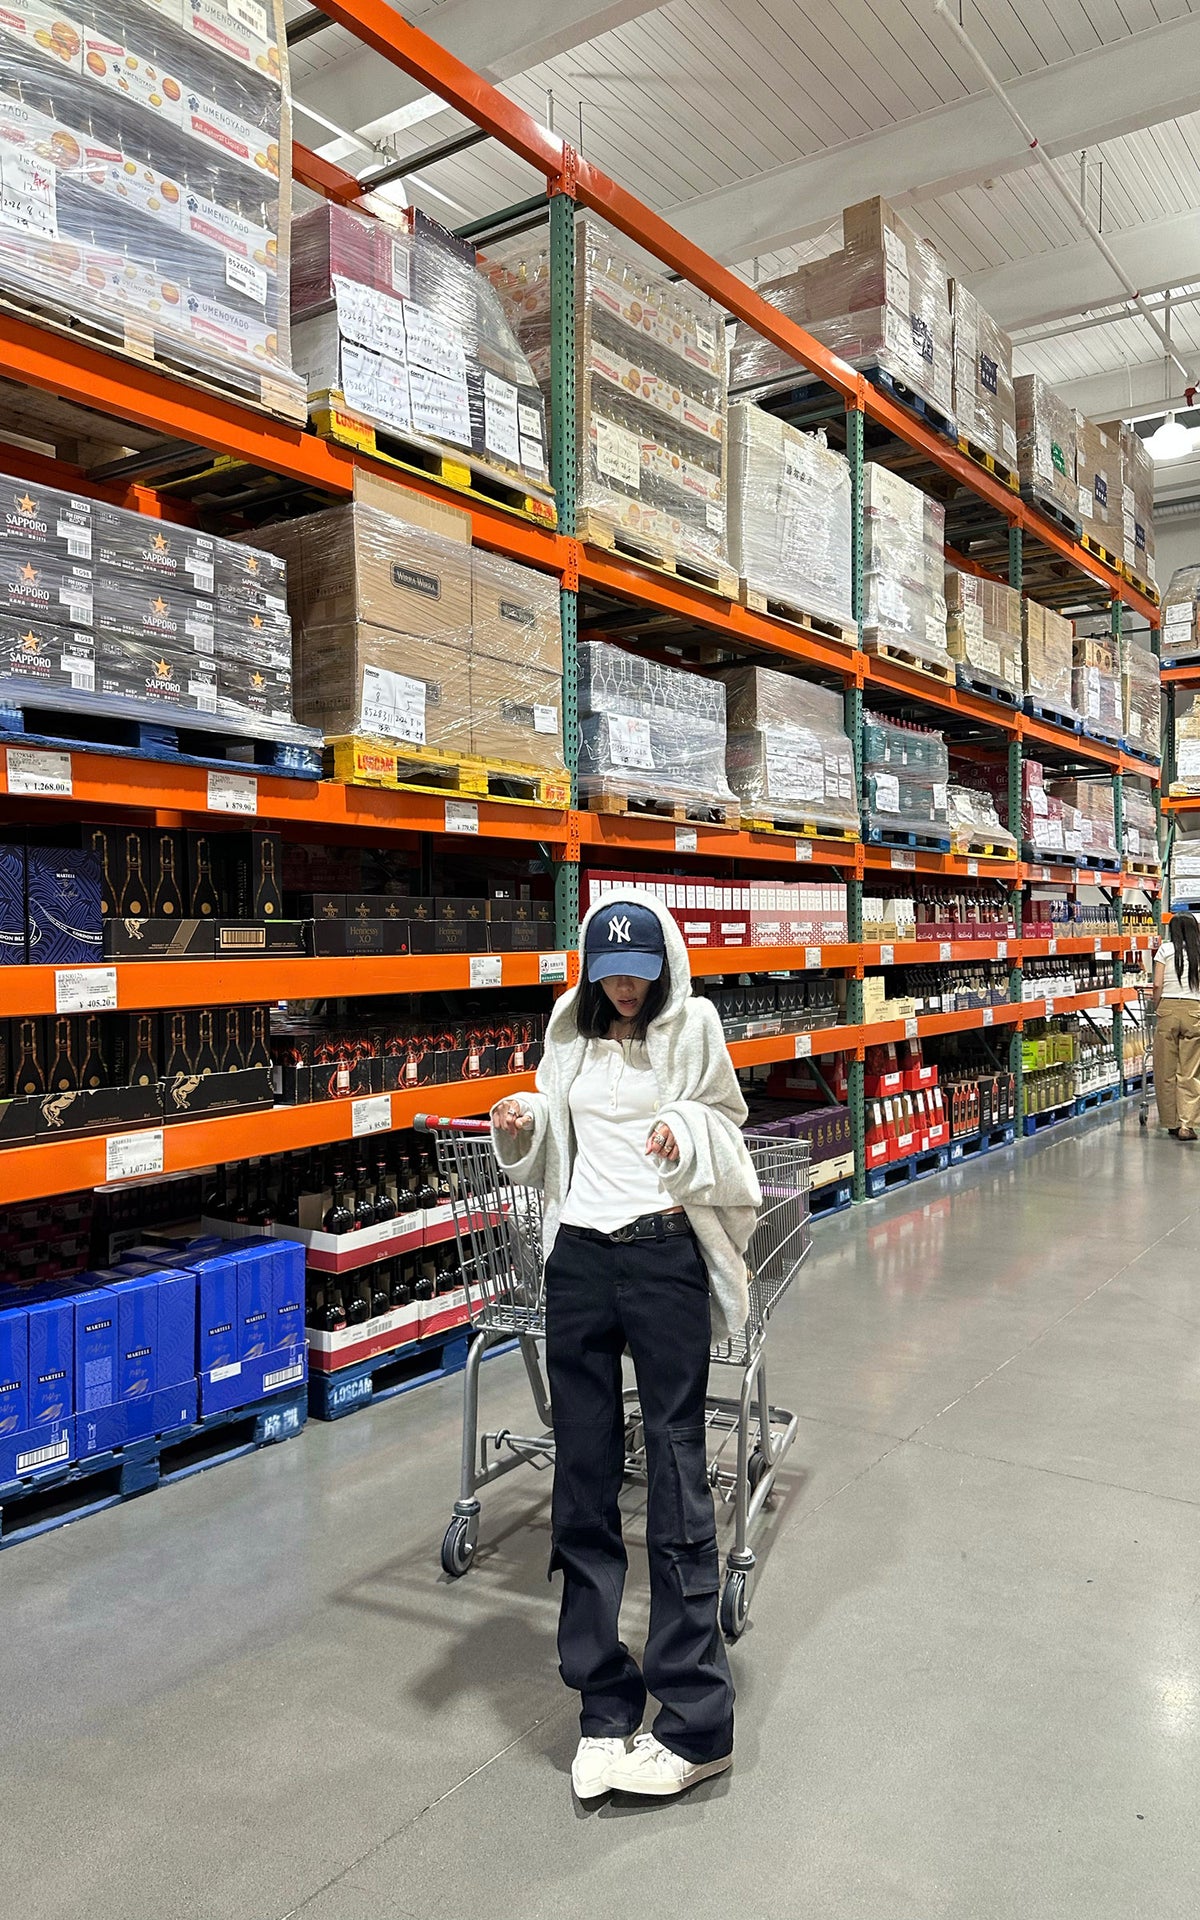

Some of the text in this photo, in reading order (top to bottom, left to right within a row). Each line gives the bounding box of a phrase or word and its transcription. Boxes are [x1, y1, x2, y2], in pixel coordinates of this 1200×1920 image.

[203, 104, 251, 136] UMENOYADO
[202, 204, 249, 234] UMENOYADO
[202, 303, 249, 330] UMENOYADO
[6, 513, 47, 533] SAPPORO
[142, 550, 177, 568] SAPPORO
[8, 582, 50, 600] SAPPORO
[142, 615, 178, 632] SAPPORO
[9, 652, 52, 668] SAPPORO
[145, 678, 180, 692] SAPPORO
[34, 782, 65, 791] 1,268.00
[350, 926, 378, 936] Hennessy
[607, 914, 632, 944] NY
[359, 935, 372, 943] XO
[87, 999, 111, 1008] 405.20
[129, 1162, 157, 1174] 1,071.20
[279, 1304, 300, 1314] MARTELL
[246, 1314, 266, 1323] MARTELL
[86, 1321, 111, 1332] MARTELL
[209, 1325, 231, 1335] MARTELL
[126, 1348, 151, 1359] MARTELL
[39, 1372, 65, 1383] MARTELL
[0, 1383, 20, 1393] ARTELL
[333, 1377, 373, 1405] LOSCAM
